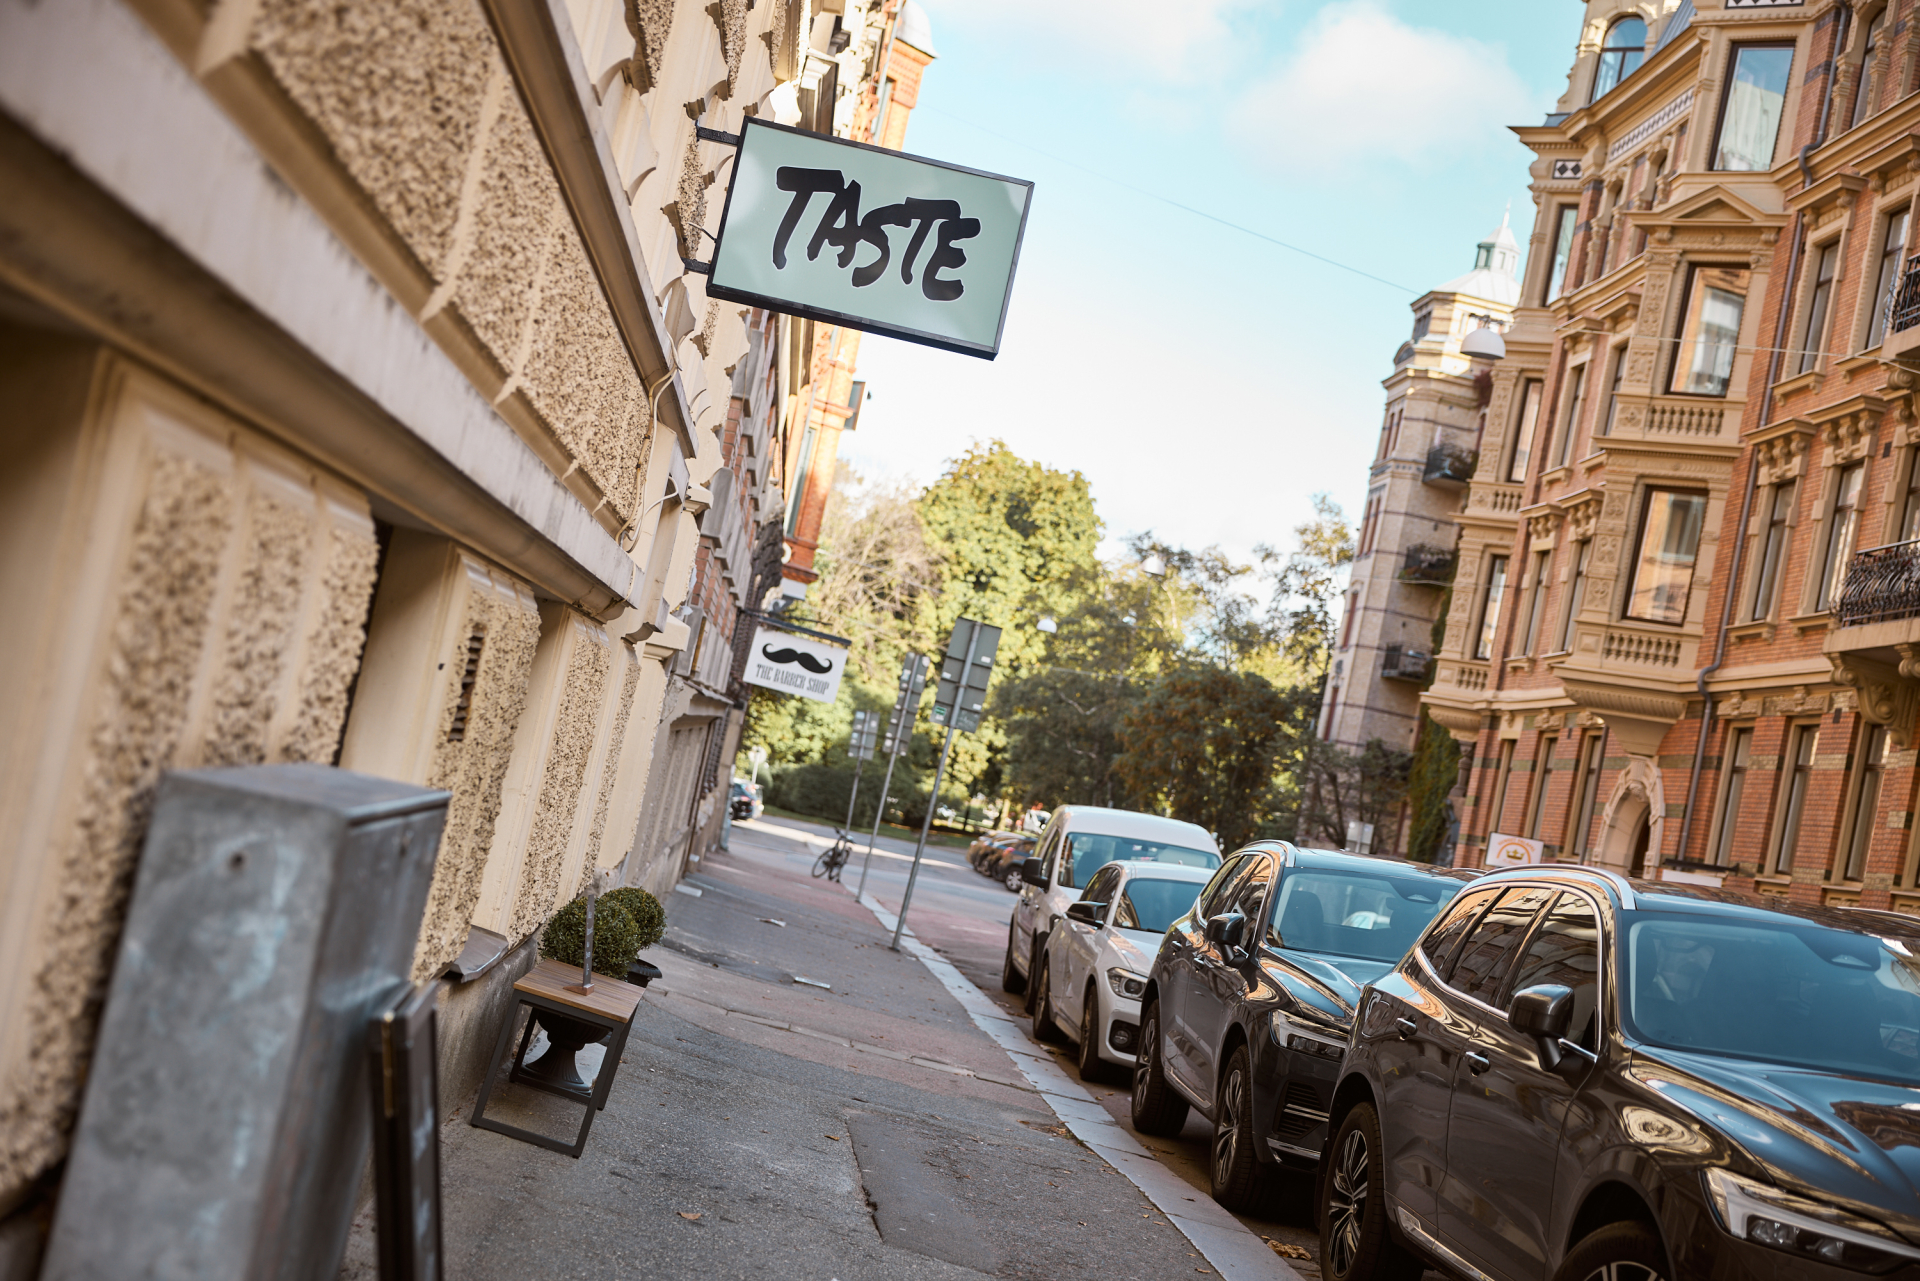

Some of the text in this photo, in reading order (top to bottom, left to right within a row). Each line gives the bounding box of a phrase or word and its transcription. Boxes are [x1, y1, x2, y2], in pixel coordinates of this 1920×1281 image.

[772, 166, 981, 301] TASTE
[756, 663, 830, 695] THE BARBER SHOP
